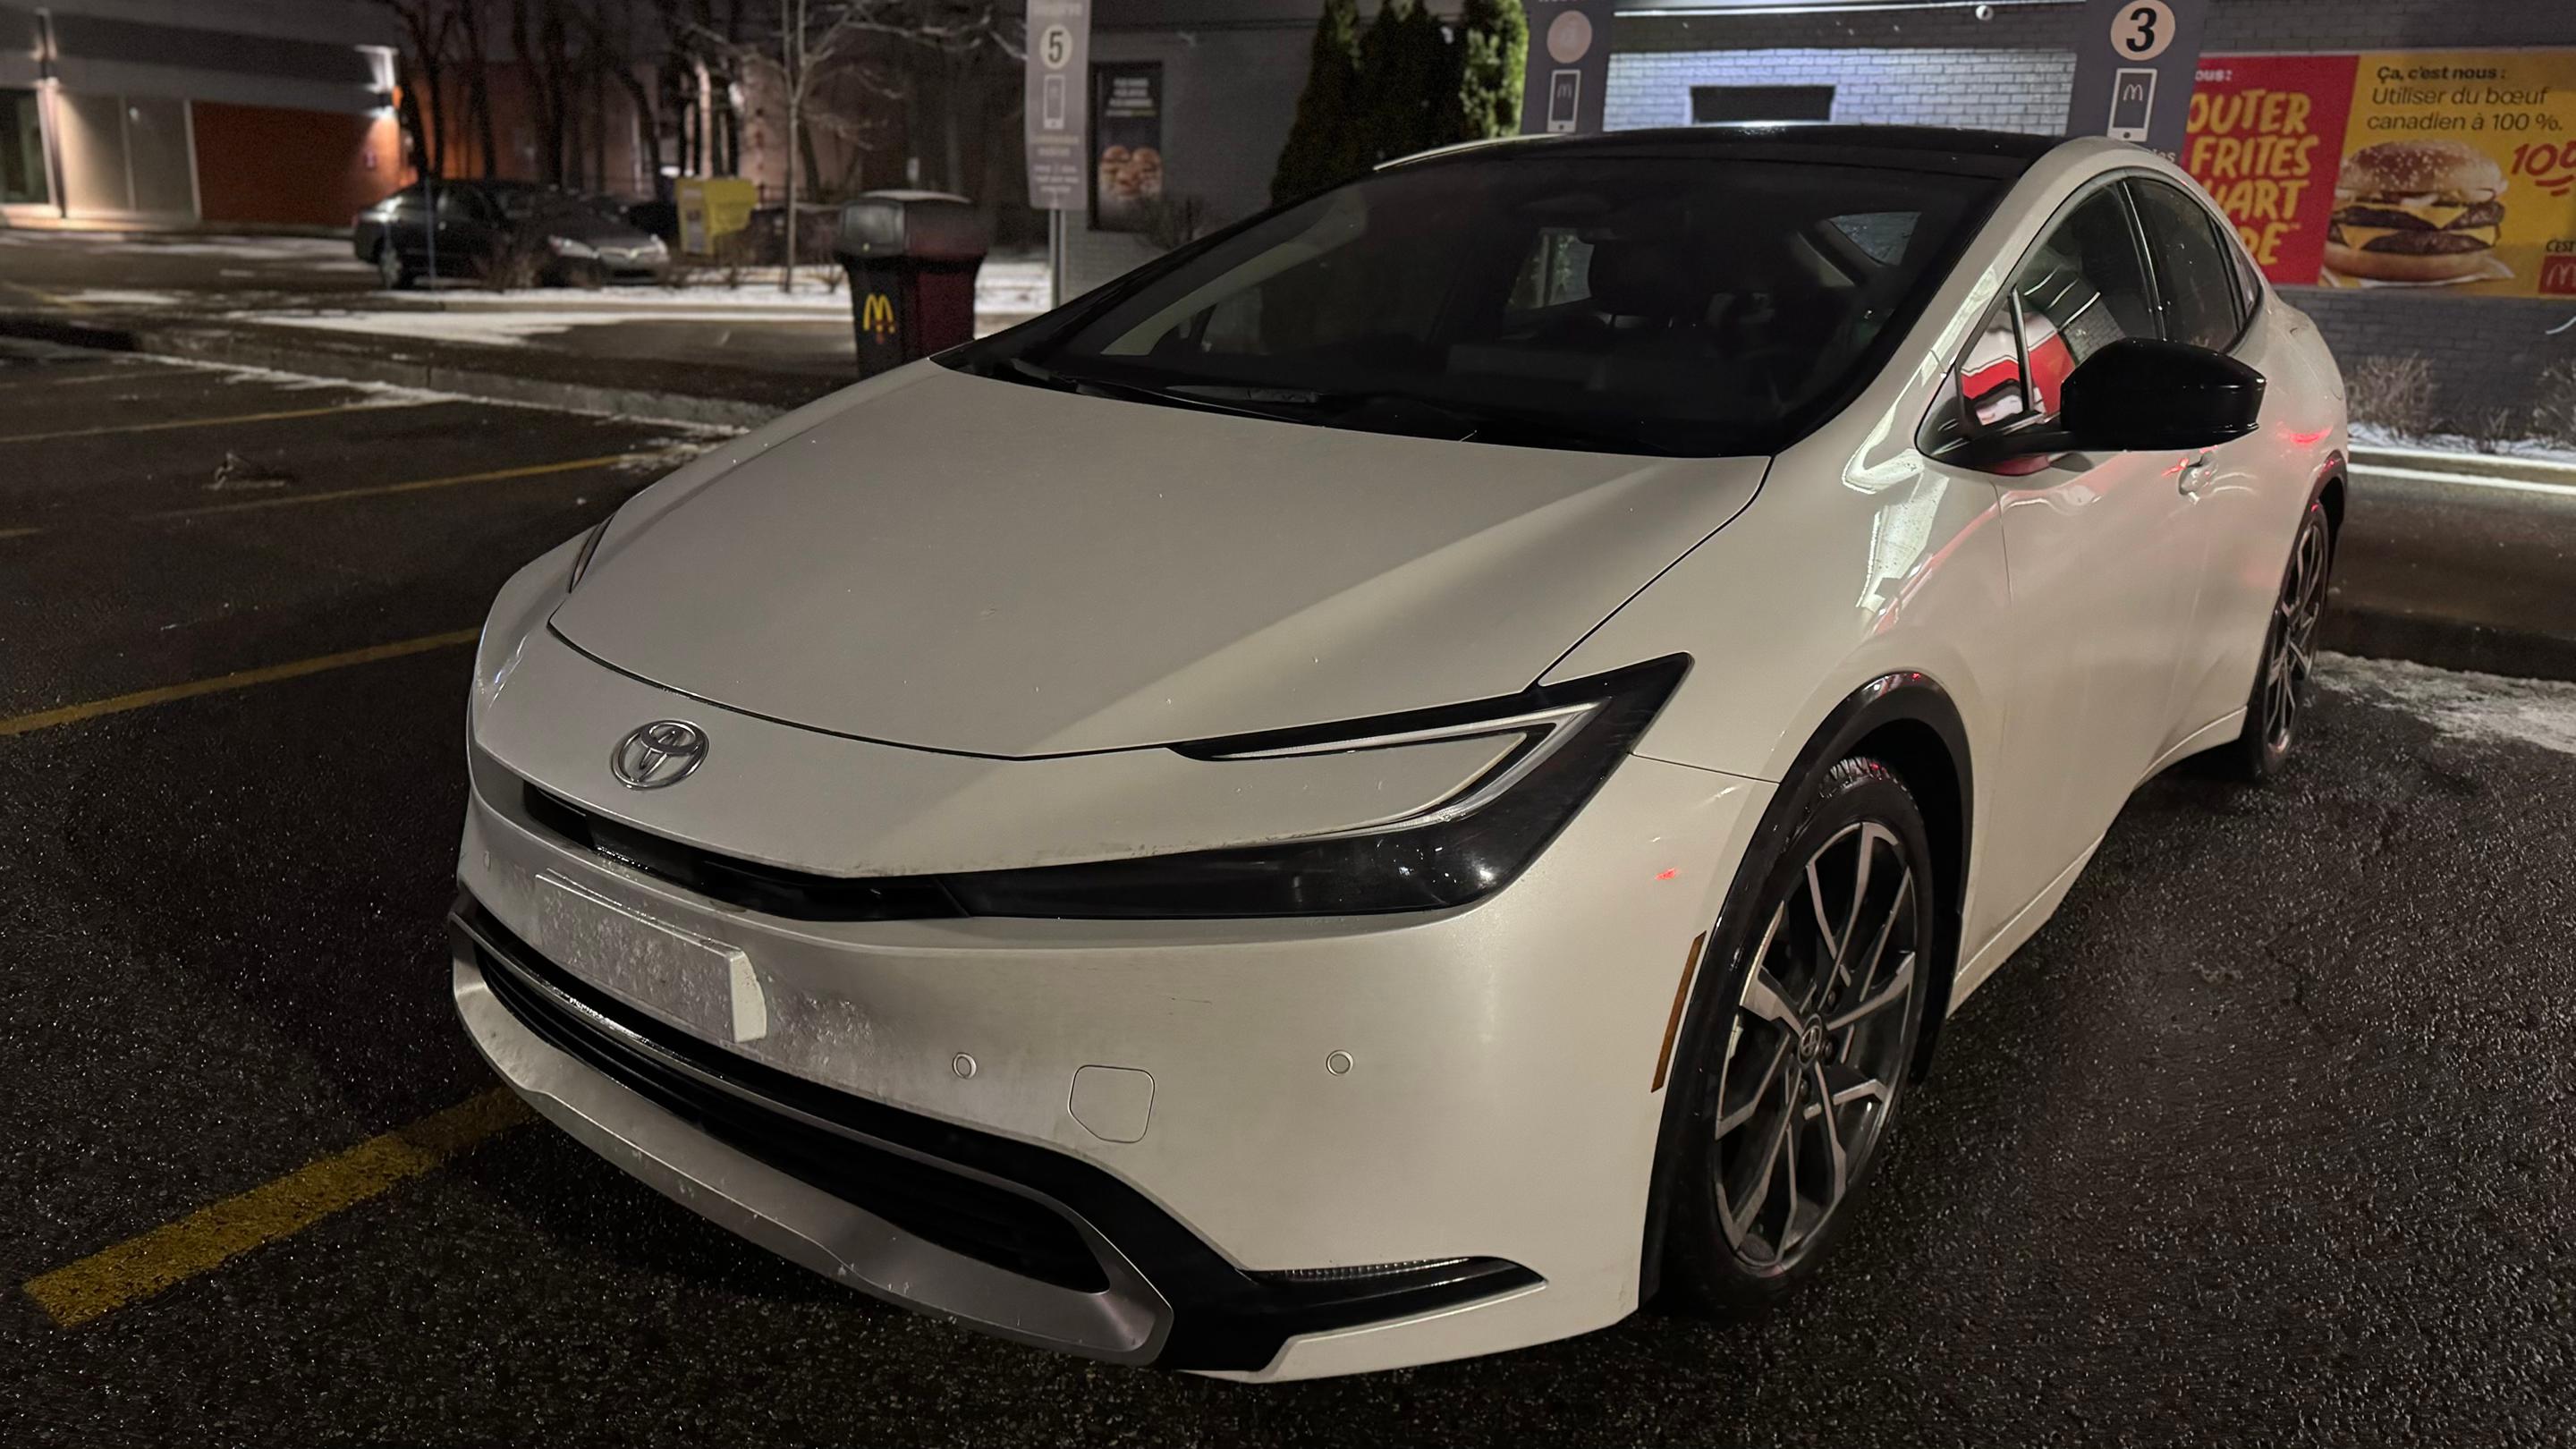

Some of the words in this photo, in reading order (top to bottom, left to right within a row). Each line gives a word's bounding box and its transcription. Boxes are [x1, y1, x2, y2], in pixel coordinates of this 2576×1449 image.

[2126, 7, 2157, 52] 3
[1048, 30, 1063, 64] 5
[2377, 65, 2404, 84] Ça,
[2408, 66, 2449, 80] c'est
[2452, 67, 2496, 80] nous
[2372, 88, 2445, 105] Utiliser
[2452, 88, 2479, 105] du
[2486, 88, 2549, 105] bœuf
[2367, 113, 2465, 130] canadien
[2471, 113, 2485, 131] à
[2493, 113, 2529, 131] 100
[2191, 134, 2318, 178] FRITES
